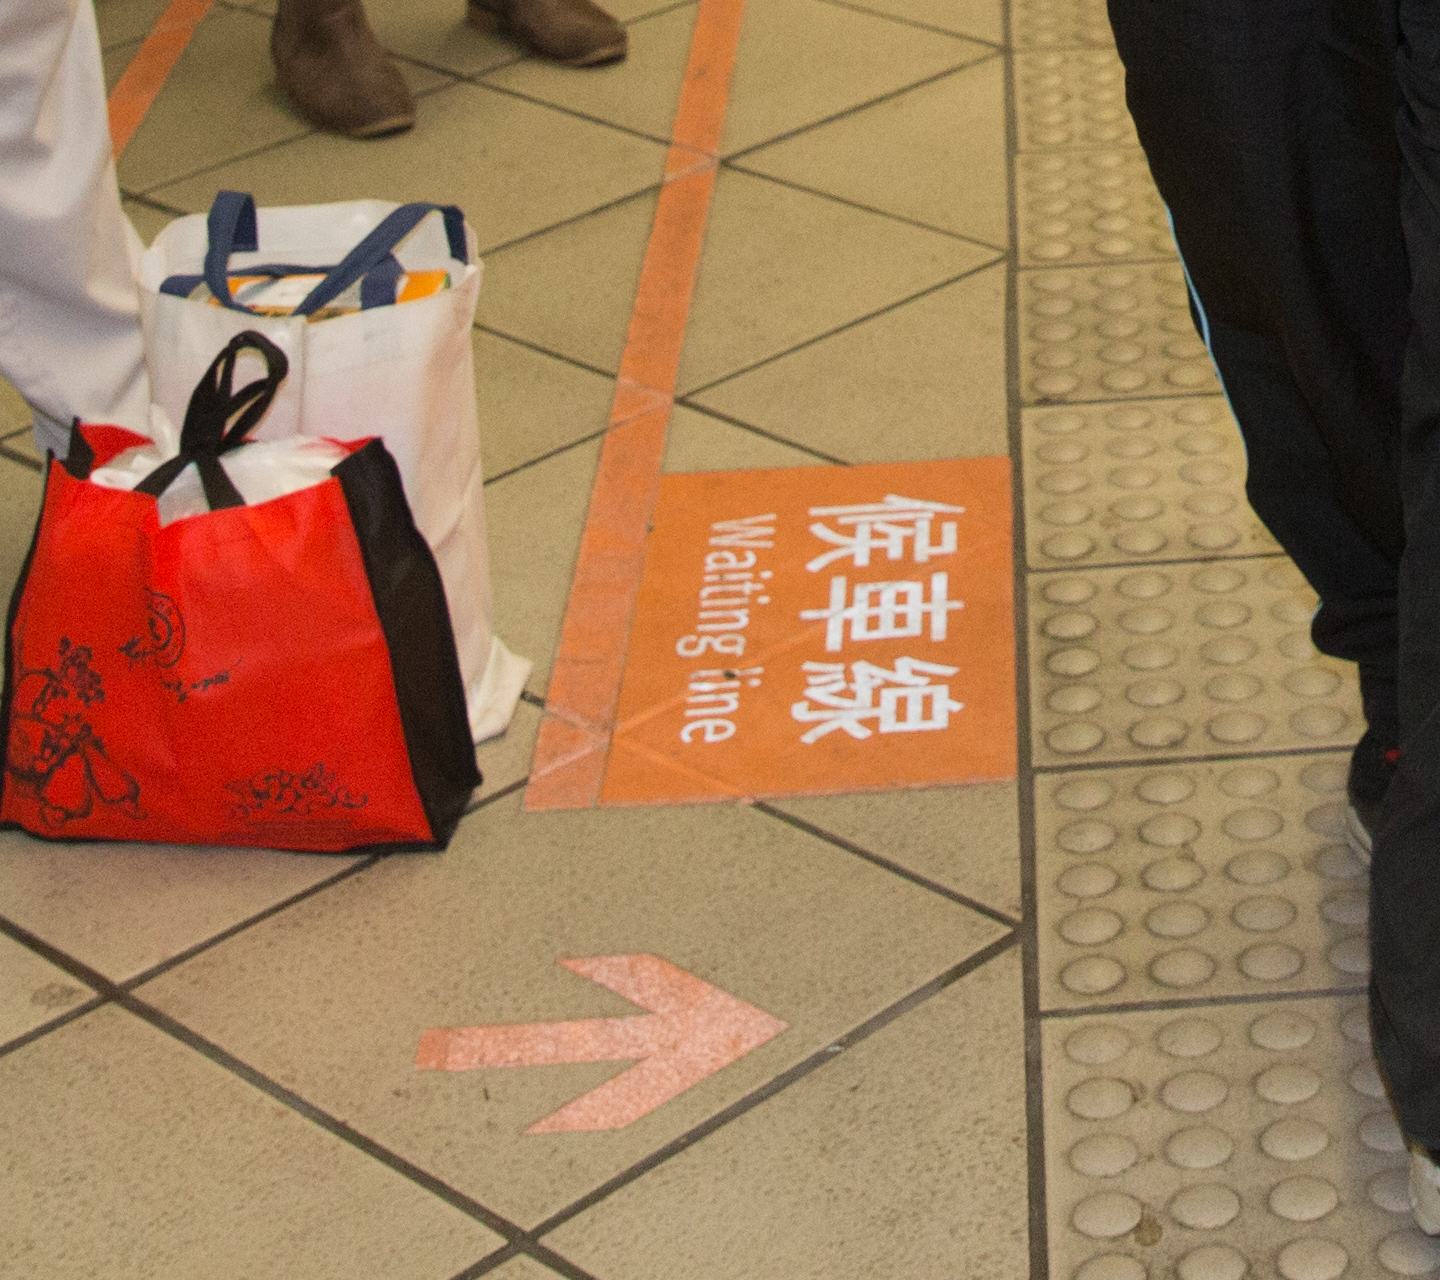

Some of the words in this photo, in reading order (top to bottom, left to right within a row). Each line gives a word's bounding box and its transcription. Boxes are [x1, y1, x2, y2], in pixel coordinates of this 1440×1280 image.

[675, 513, 777, 659] Waiting
[790, 493, 966, 745] 候車線
[680, 666, 764, 744] line
